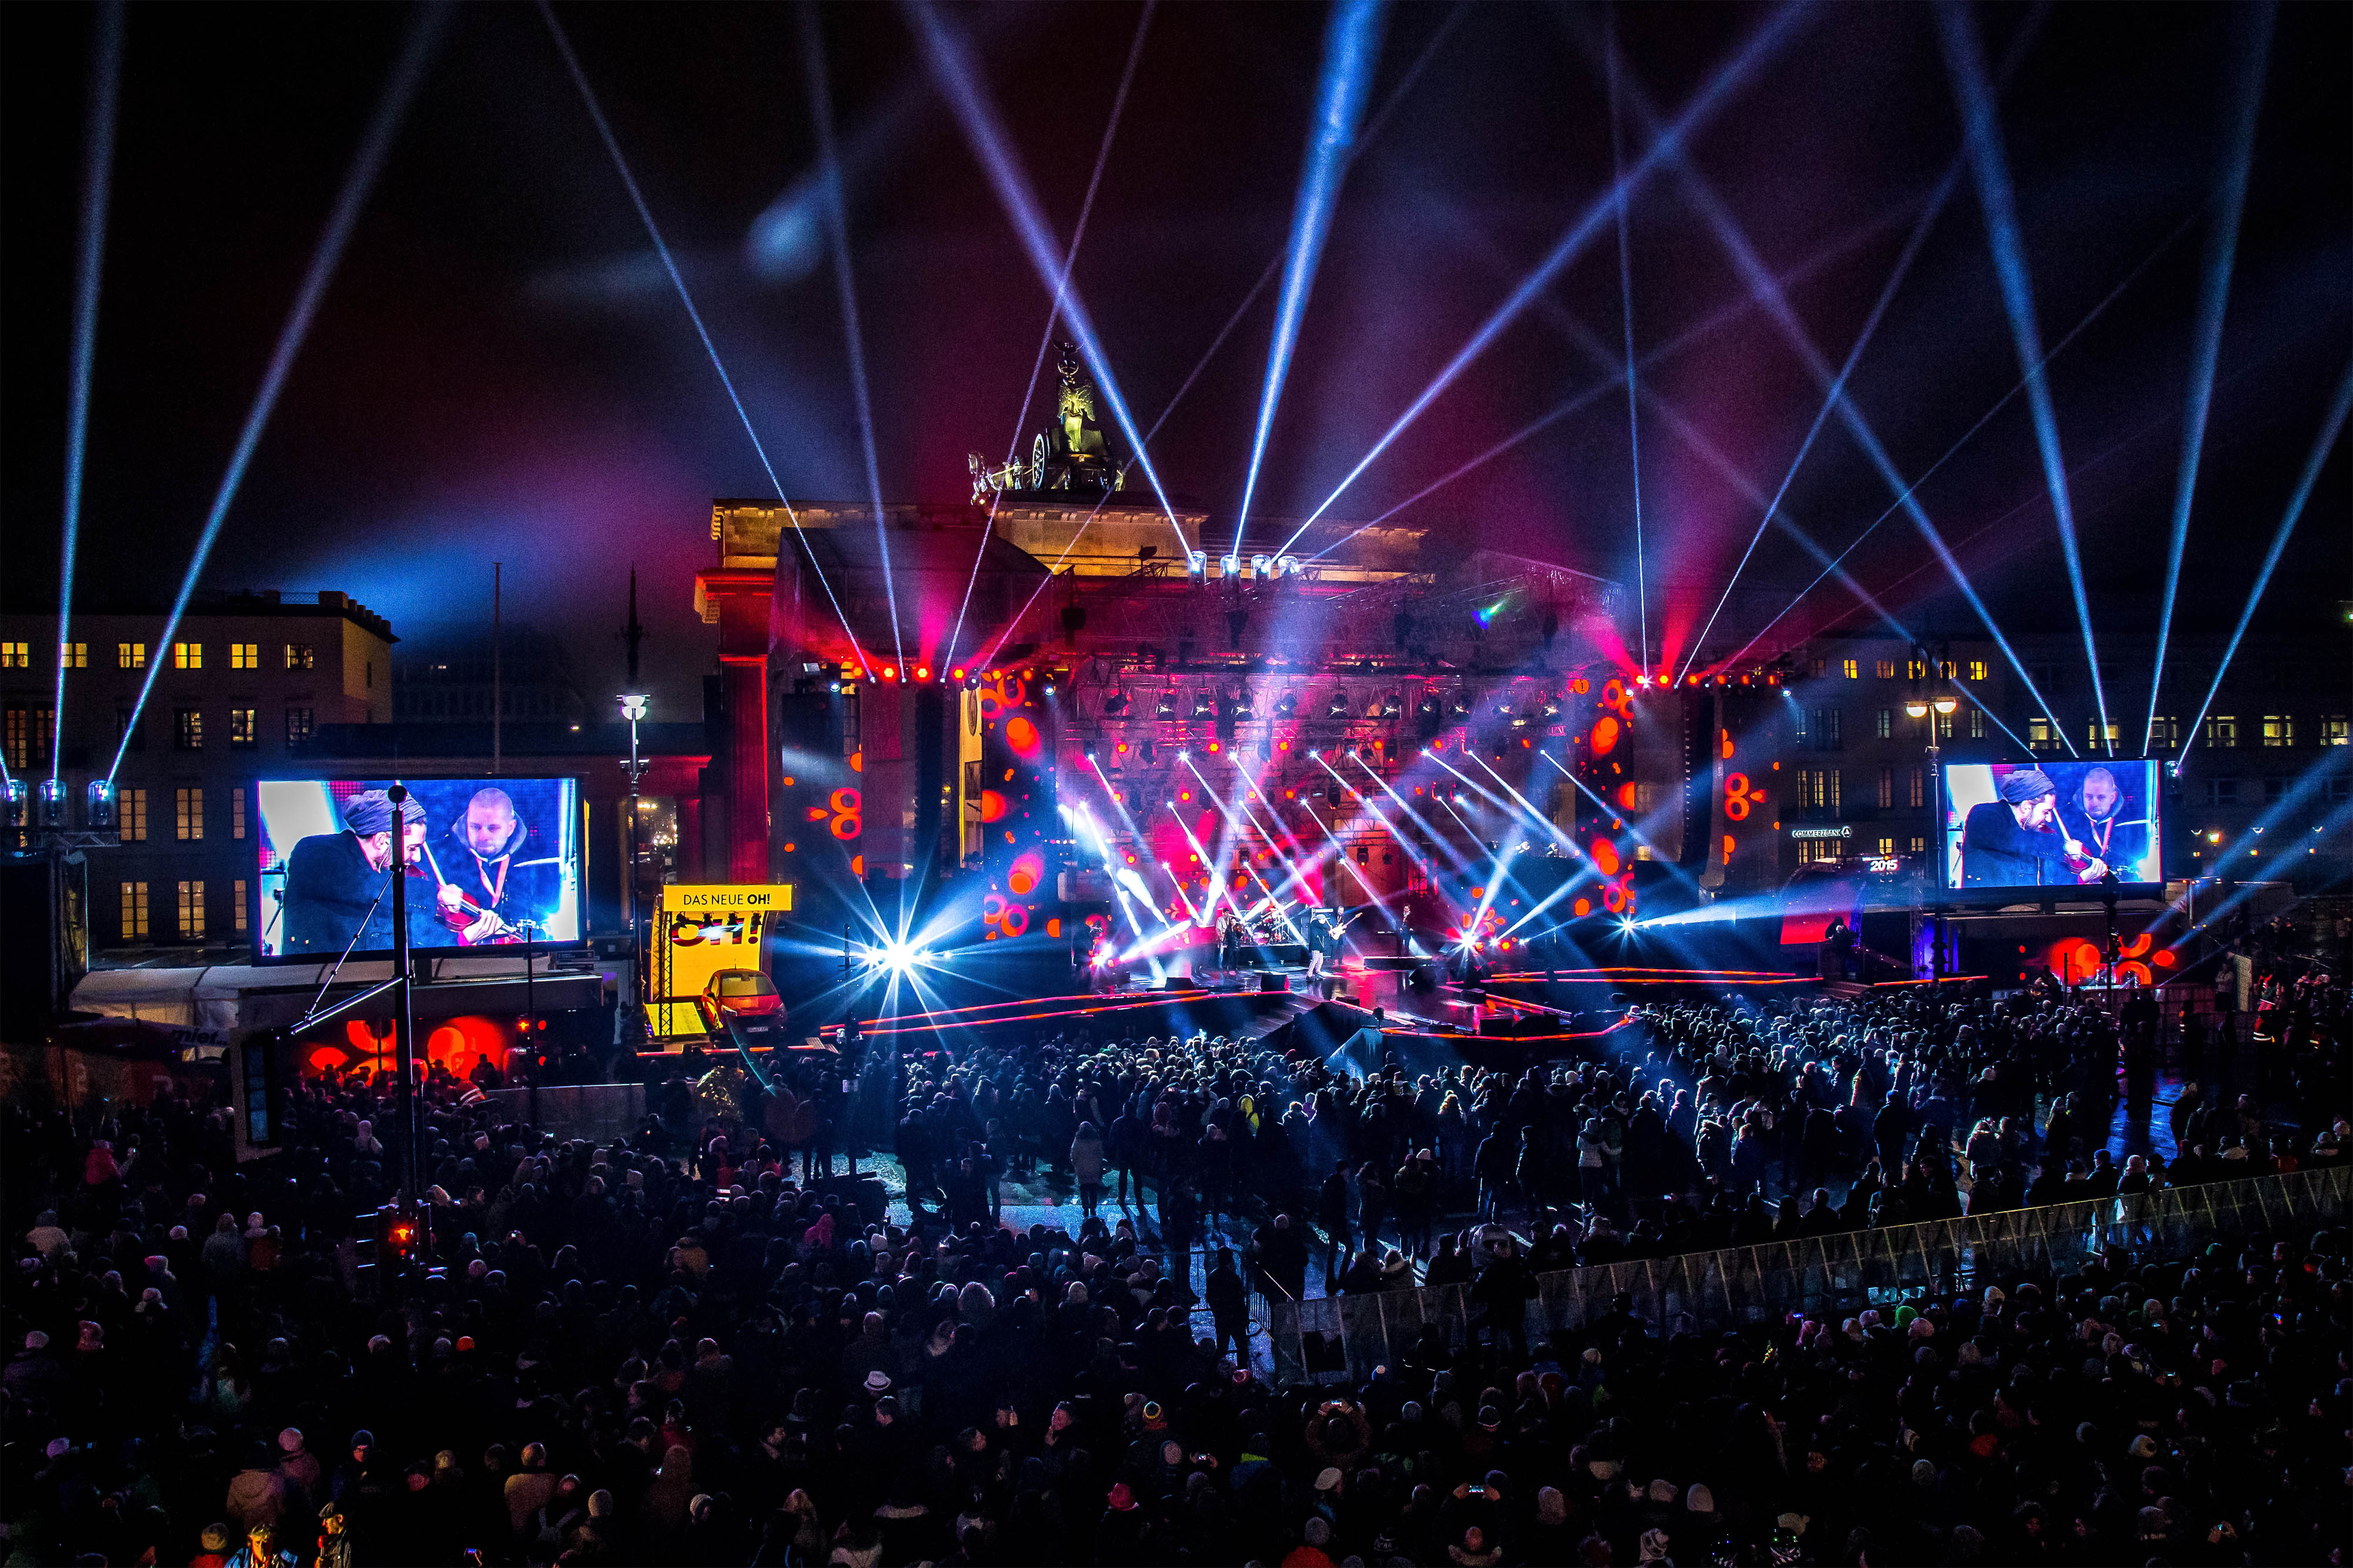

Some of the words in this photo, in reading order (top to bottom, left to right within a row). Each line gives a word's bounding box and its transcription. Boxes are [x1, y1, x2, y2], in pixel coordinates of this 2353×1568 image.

[1792, 829, 1842, 838] COMMERZBANK
[1870, 859, 1898, 872] 2015
[683, 894, 708, 905] DAS
[711, 893, 744, 905] NEUE
[747, 893, 771, 905] OH!
